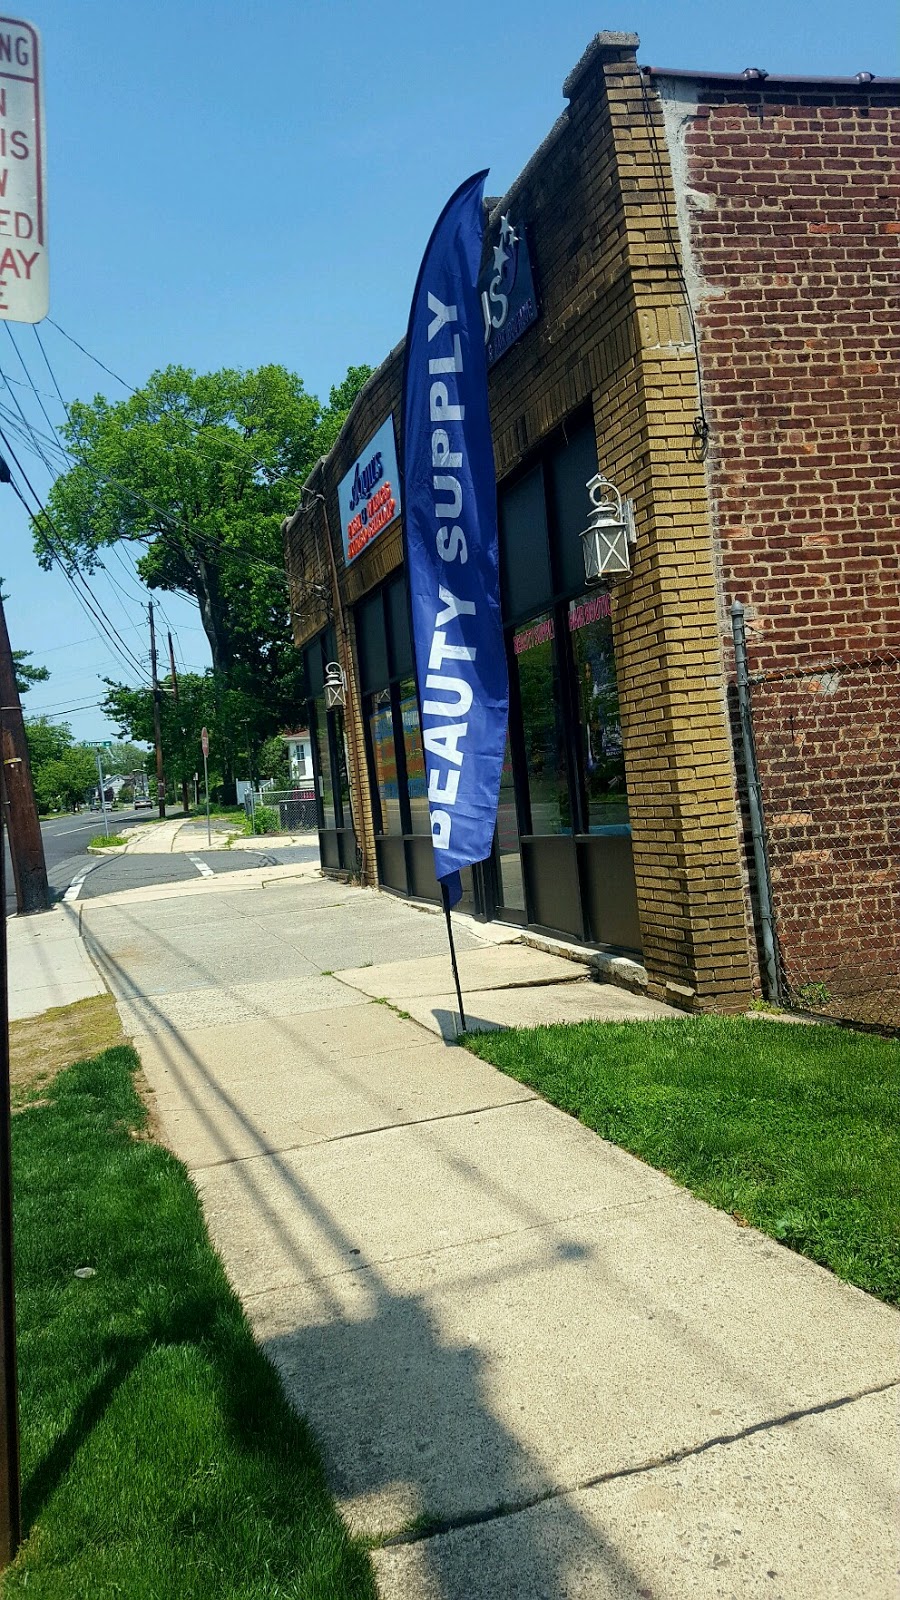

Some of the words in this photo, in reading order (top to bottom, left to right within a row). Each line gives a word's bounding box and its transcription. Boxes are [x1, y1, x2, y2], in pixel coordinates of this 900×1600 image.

[428, 291, 467, 565] SUPPLY
[533, 618, 555, 646] SUPPL
[584, 592, 613, 624] BOUTIQ
[423, 584, 477, 850] BEAUTY
